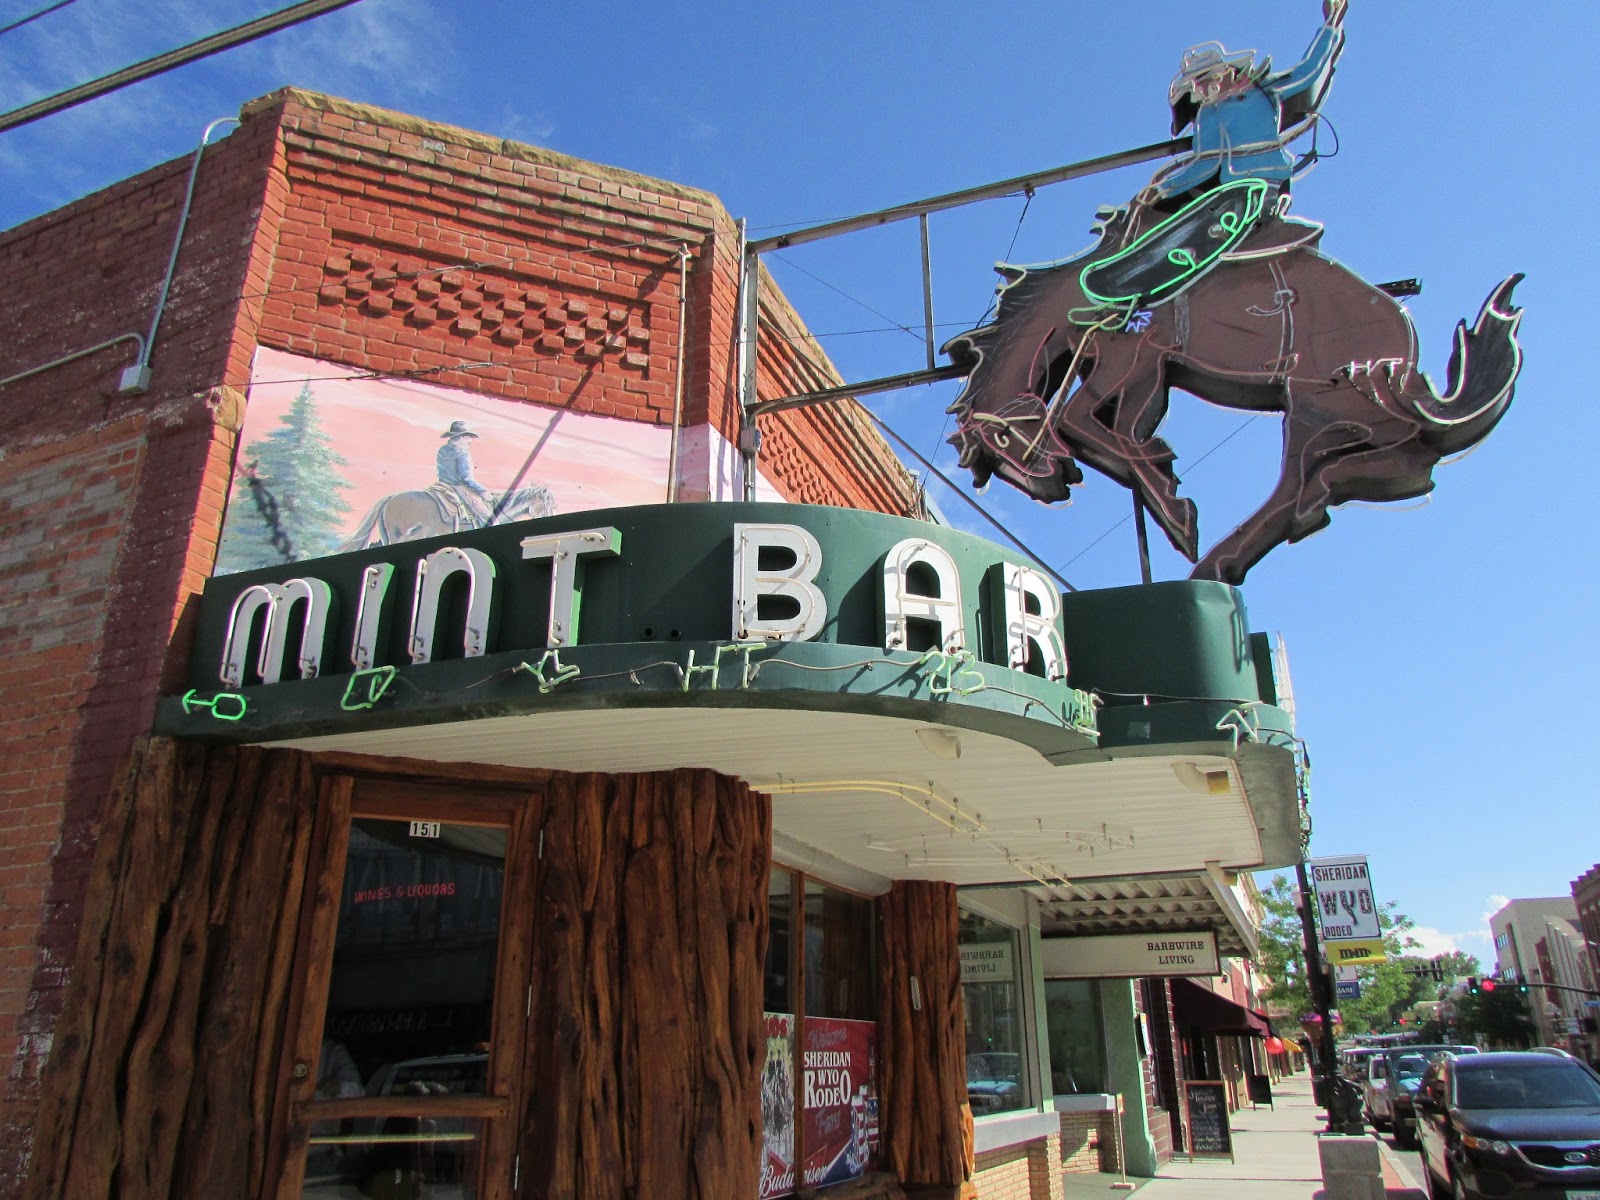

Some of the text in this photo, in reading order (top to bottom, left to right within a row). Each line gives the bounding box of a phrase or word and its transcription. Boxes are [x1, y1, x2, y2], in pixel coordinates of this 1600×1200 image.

[219, 522, 1069, 689] MINT BAR
[412, 822, 438, 837] 151
[1315, 865, 1367, 882] SHERIDAN
[354, 883, 456, 903] WINES & LIQUORS
[1319, 889, 1372, 926] WYO
[1325, 924, 1353, 937] RODEO
[1147, 940, 1205, 951] BARBWIRE
[1159, 955, 1195, 965] LIVING
[803, 1051, 851, 1068] SHERIDAN
[819, 1068, 839, 1086] WYO
[804, 1069, 852, 1109] RODEO
